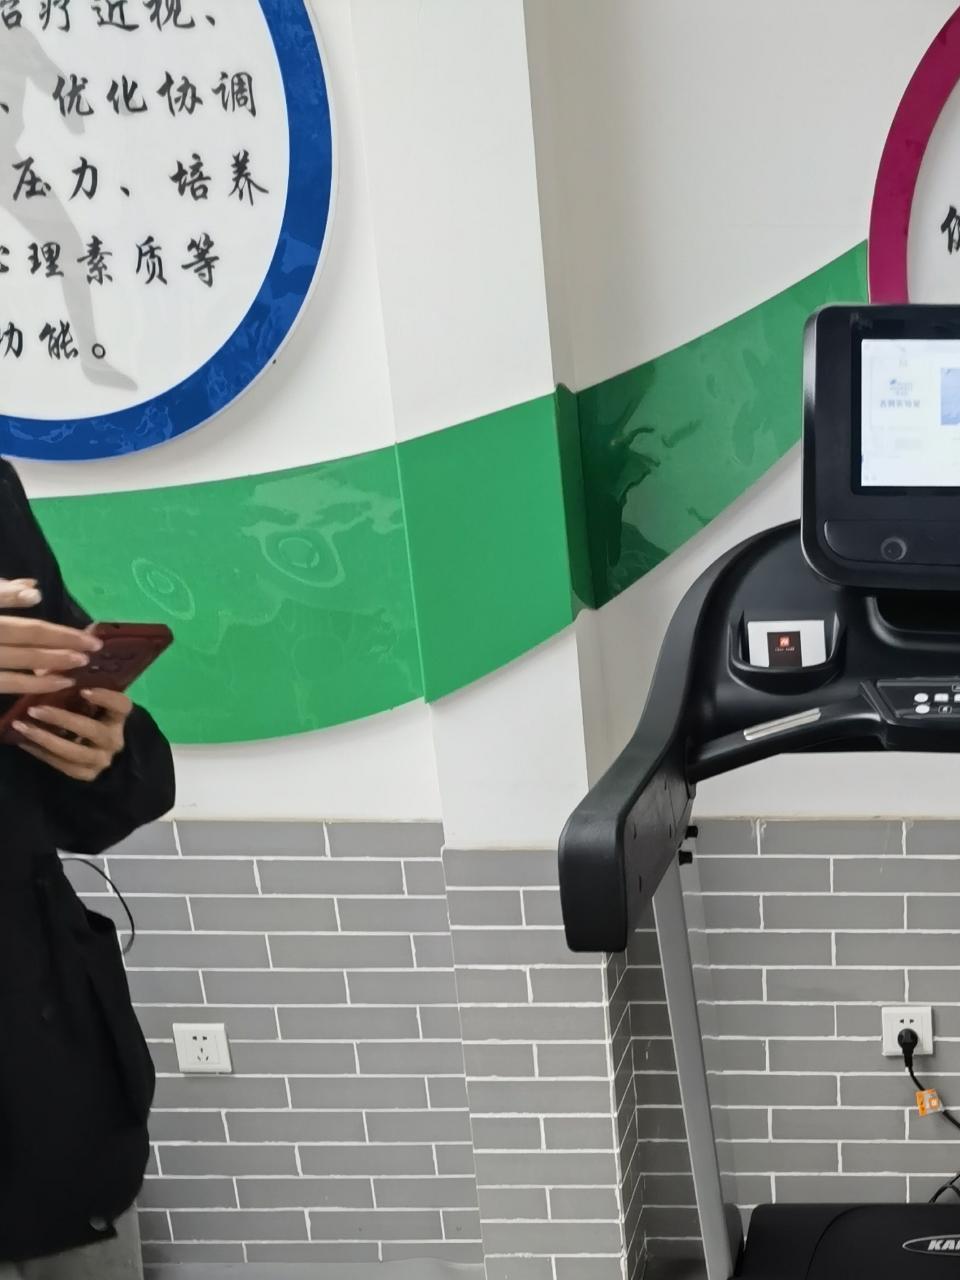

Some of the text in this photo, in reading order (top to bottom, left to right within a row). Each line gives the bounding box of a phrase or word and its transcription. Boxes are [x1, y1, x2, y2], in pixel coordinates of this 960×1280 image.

[12, 150, 268, 206] 压力、培养
[0, 232, 220, 288] 理素质等
